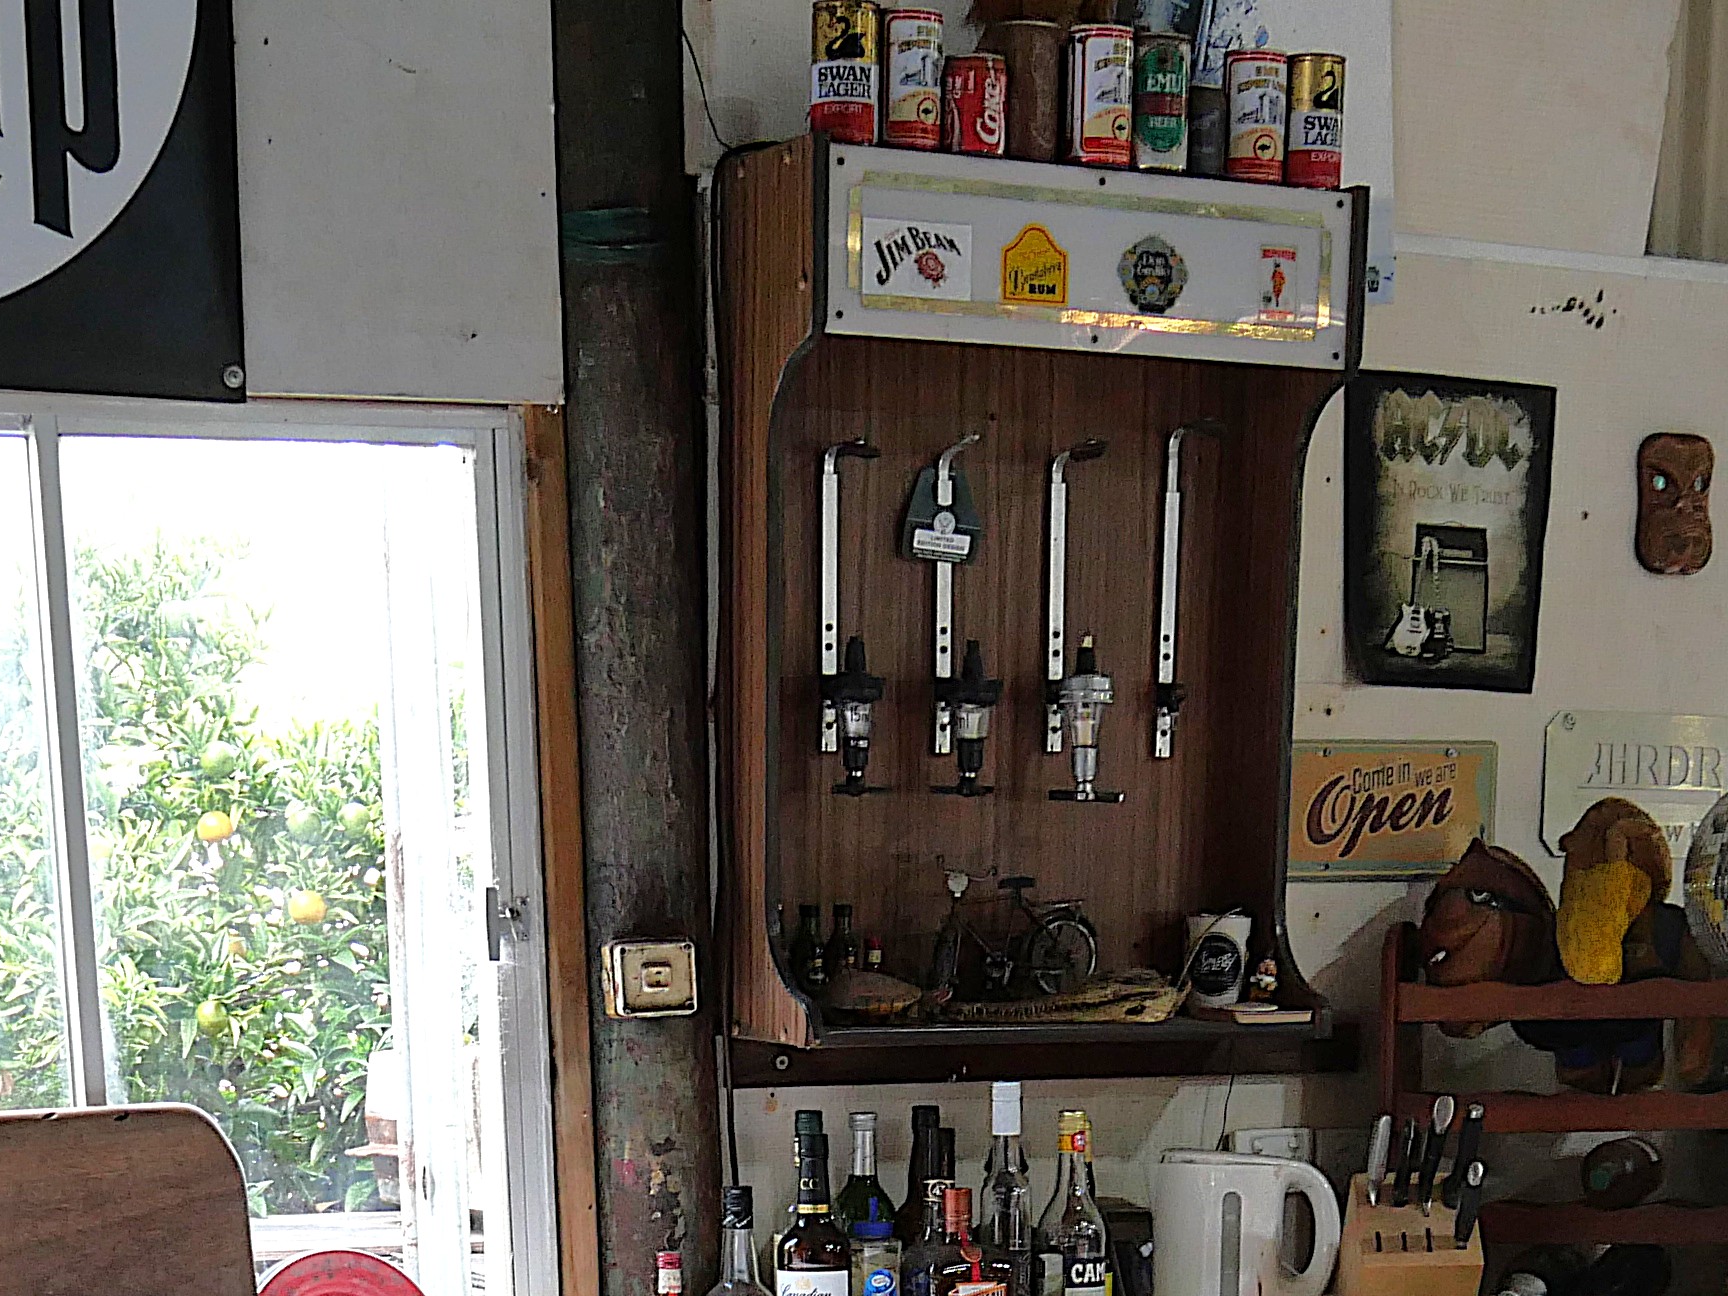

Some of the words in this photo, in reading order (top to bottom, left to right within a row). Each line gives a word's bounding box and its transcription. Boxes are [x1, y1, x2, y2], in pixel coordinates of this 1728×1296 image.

[817, 65, 872, 83] SWAN
[1147, 73, 1183, 92] EMU
[817, 82, 872, 99] LAGER
[874, 235, 913, 286] JIM
[907, 226, 962, 257] BEAM
[1028, 283, 1057, 295] RUM
[1352, 766, 1394, 794] Come
[1398, 757, 1411, 784] in
[1414, 768, 1432, 788] we
[1435, 762, 1457, 783] are
[1306, 774, 1455, 858] Open
